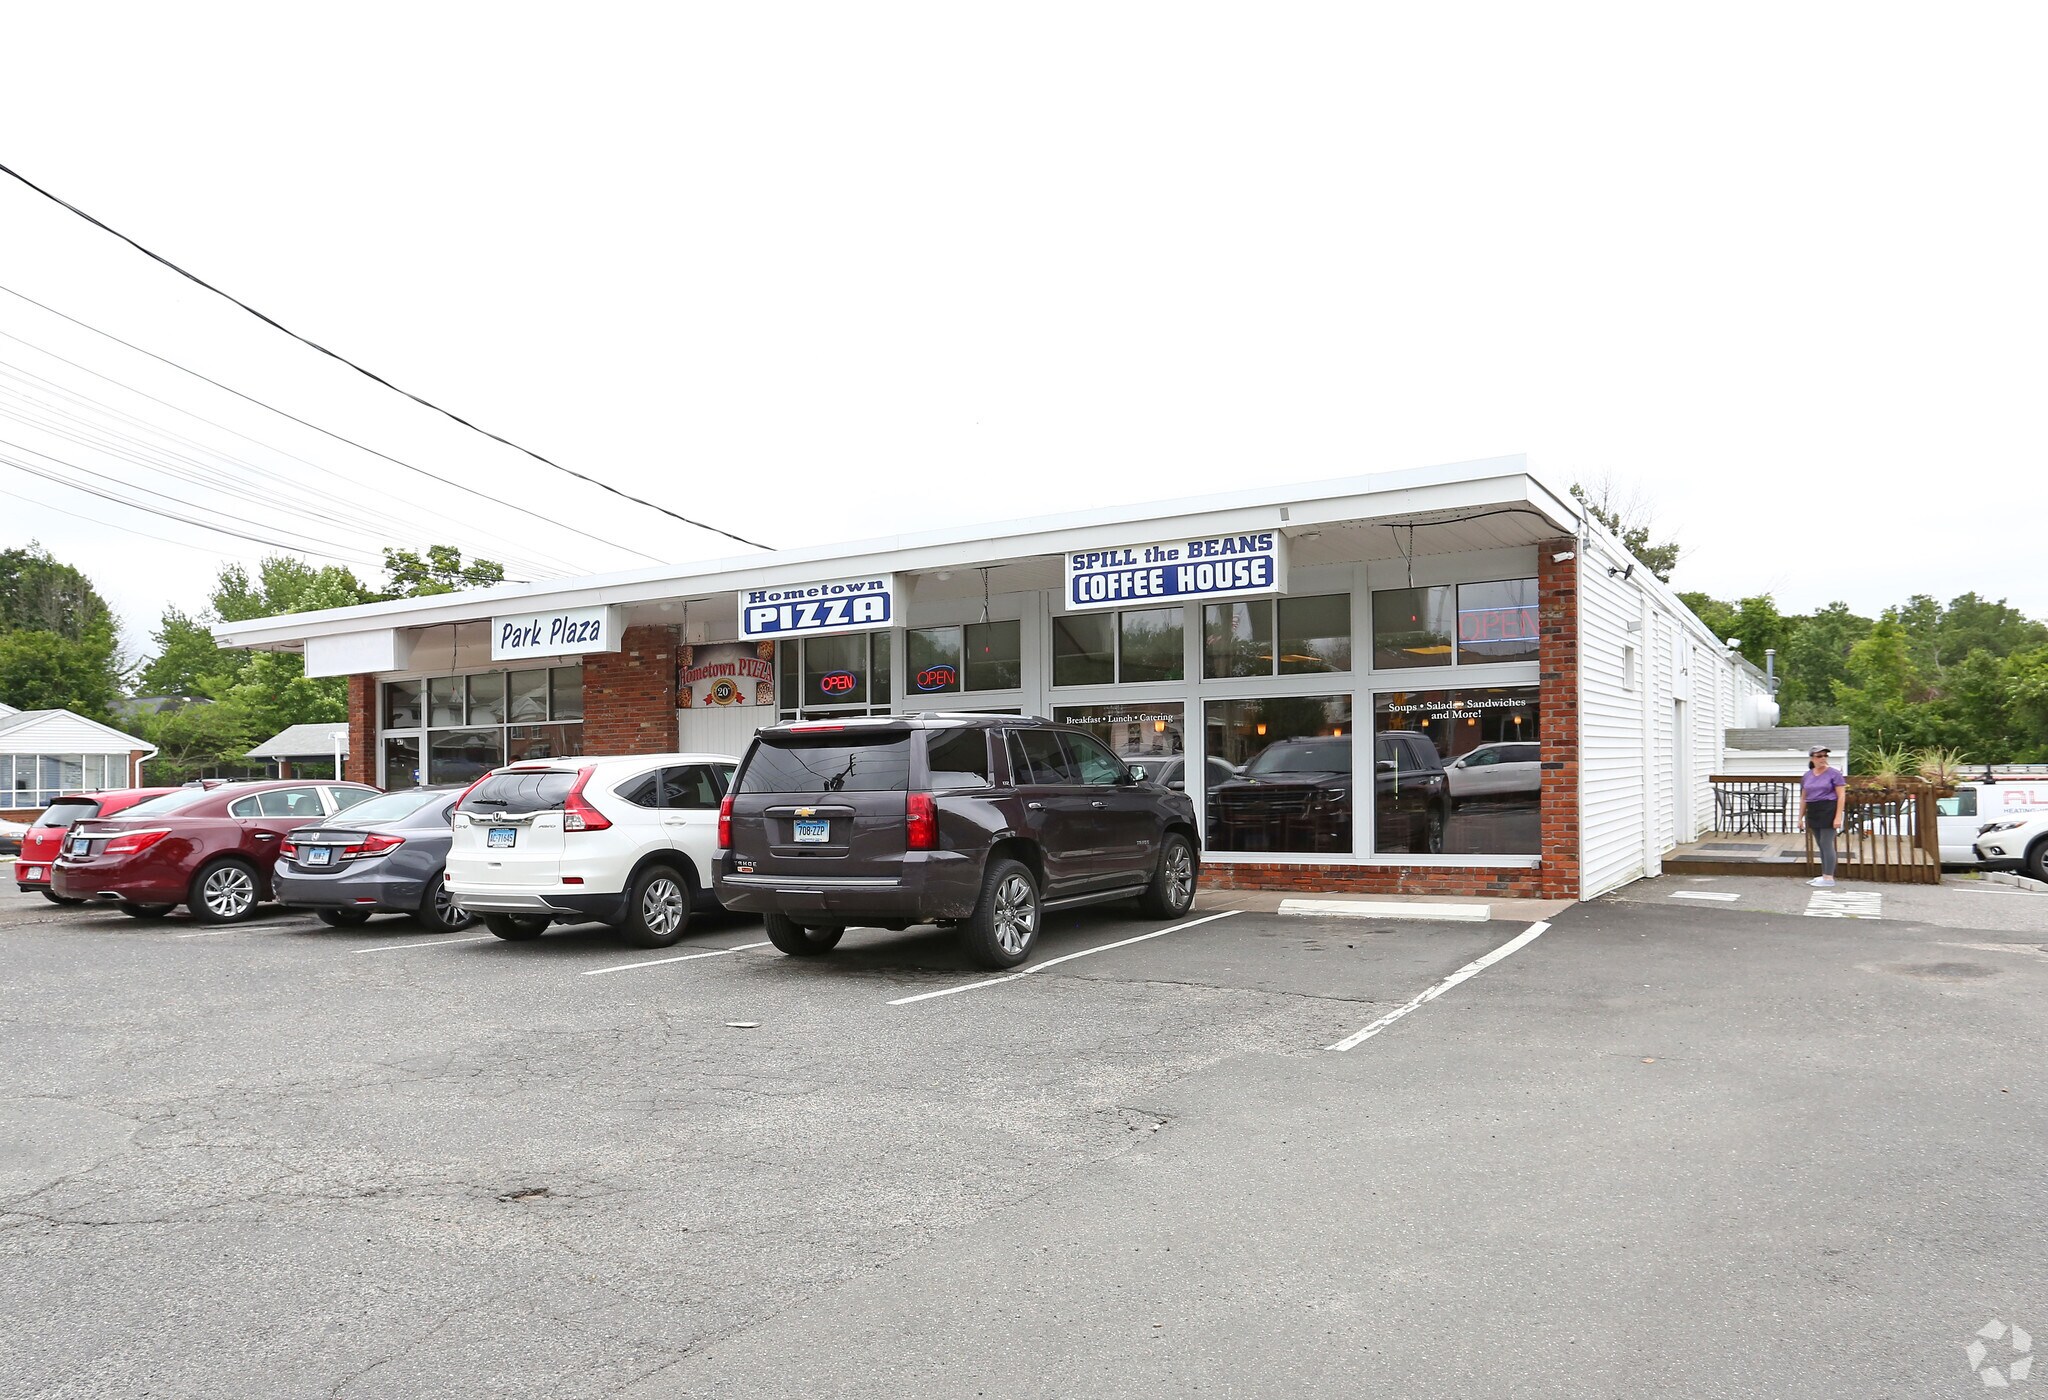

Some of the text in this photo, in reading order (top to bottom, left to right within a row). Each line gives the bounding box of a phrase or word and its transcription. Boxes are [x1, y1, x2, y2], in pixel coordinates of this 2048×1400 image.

[1073, 533, 1273, 572] SPILL the BEANS
[748, 580, 884, 604] Hometown
[1078, 557, 1266, 602] COFFEE HOUSE
[750, 596, 884, 633] PIZZA
[1459, 609, 1539, 640] OPEN
[501, 616, 600, 649] Park Plaza
[679, 658, 774, 687] Hometown PIZZA
[822, 676, 853, 691] OPEN
[917, 670, 955, 685] OPEN
[1066, 713, 1174, 724] Breakfast Lunch Catering
[1388, 703, 1417, 714] Soups
[1467, 698, 1526, 709] Sandwiches
[1431, 709, 1482, 719] and More!
